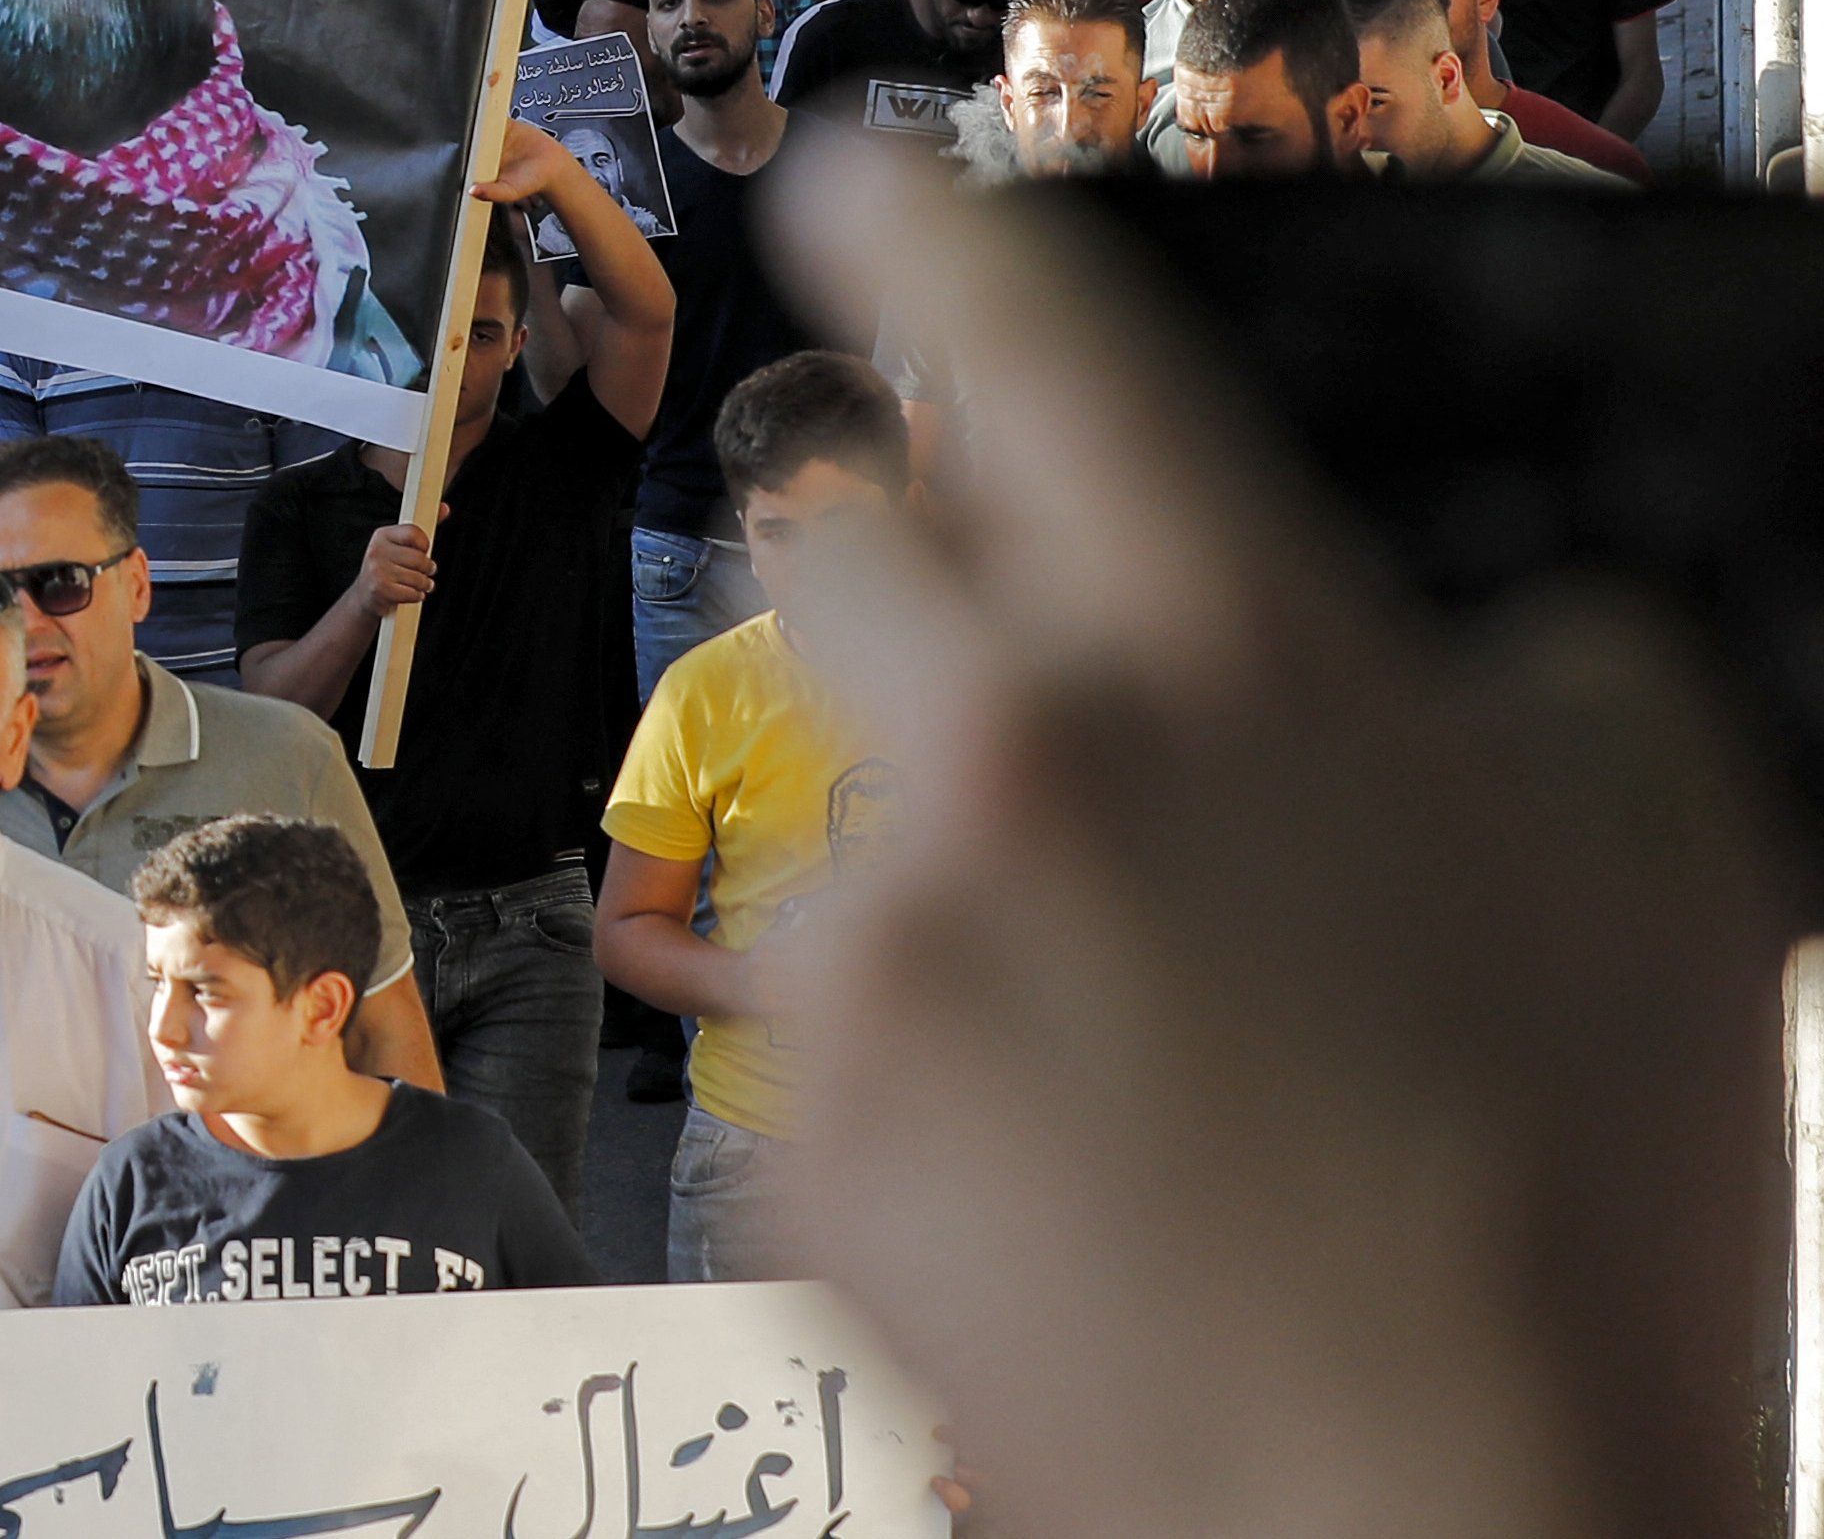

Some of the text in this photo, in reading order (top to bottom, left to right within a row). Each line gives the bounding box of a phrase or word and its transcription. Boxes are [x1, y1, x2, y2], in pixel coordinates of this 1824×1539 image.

[516, 45, 634, 82] سلطتنا سلطة عتلا
[519, 89, 552, 108] بنات
[555, 83, 582, 107] نزار
[220, 1235, 412, 1301] SELECT
